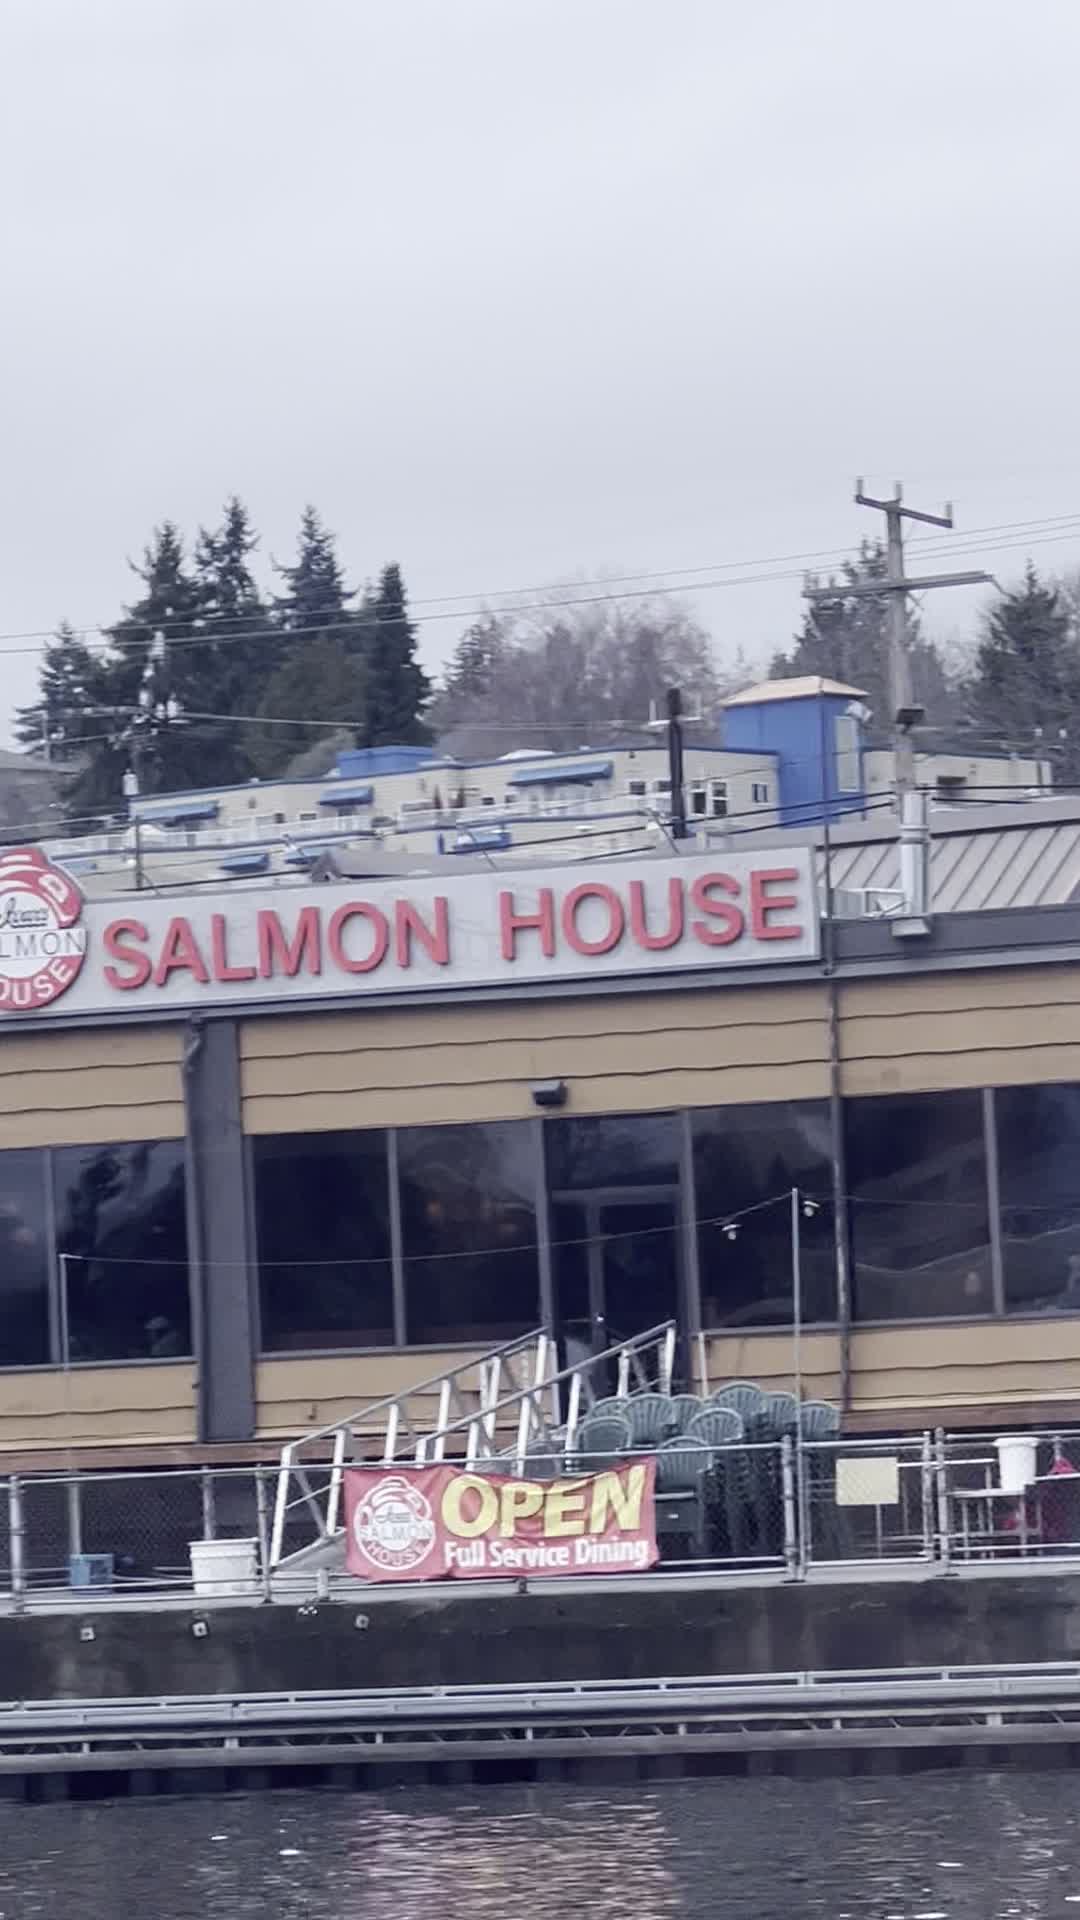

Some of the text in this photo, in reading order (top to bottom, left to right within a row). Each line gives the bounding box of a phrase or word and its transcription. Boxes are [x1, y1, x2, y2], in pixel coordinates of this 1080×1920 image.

[103, 868, 803, 990] SALMON HOUSE
[441, 1464, 646, 1538] OPEN
[444, 1536, 649, 1568] Full Service Dining
